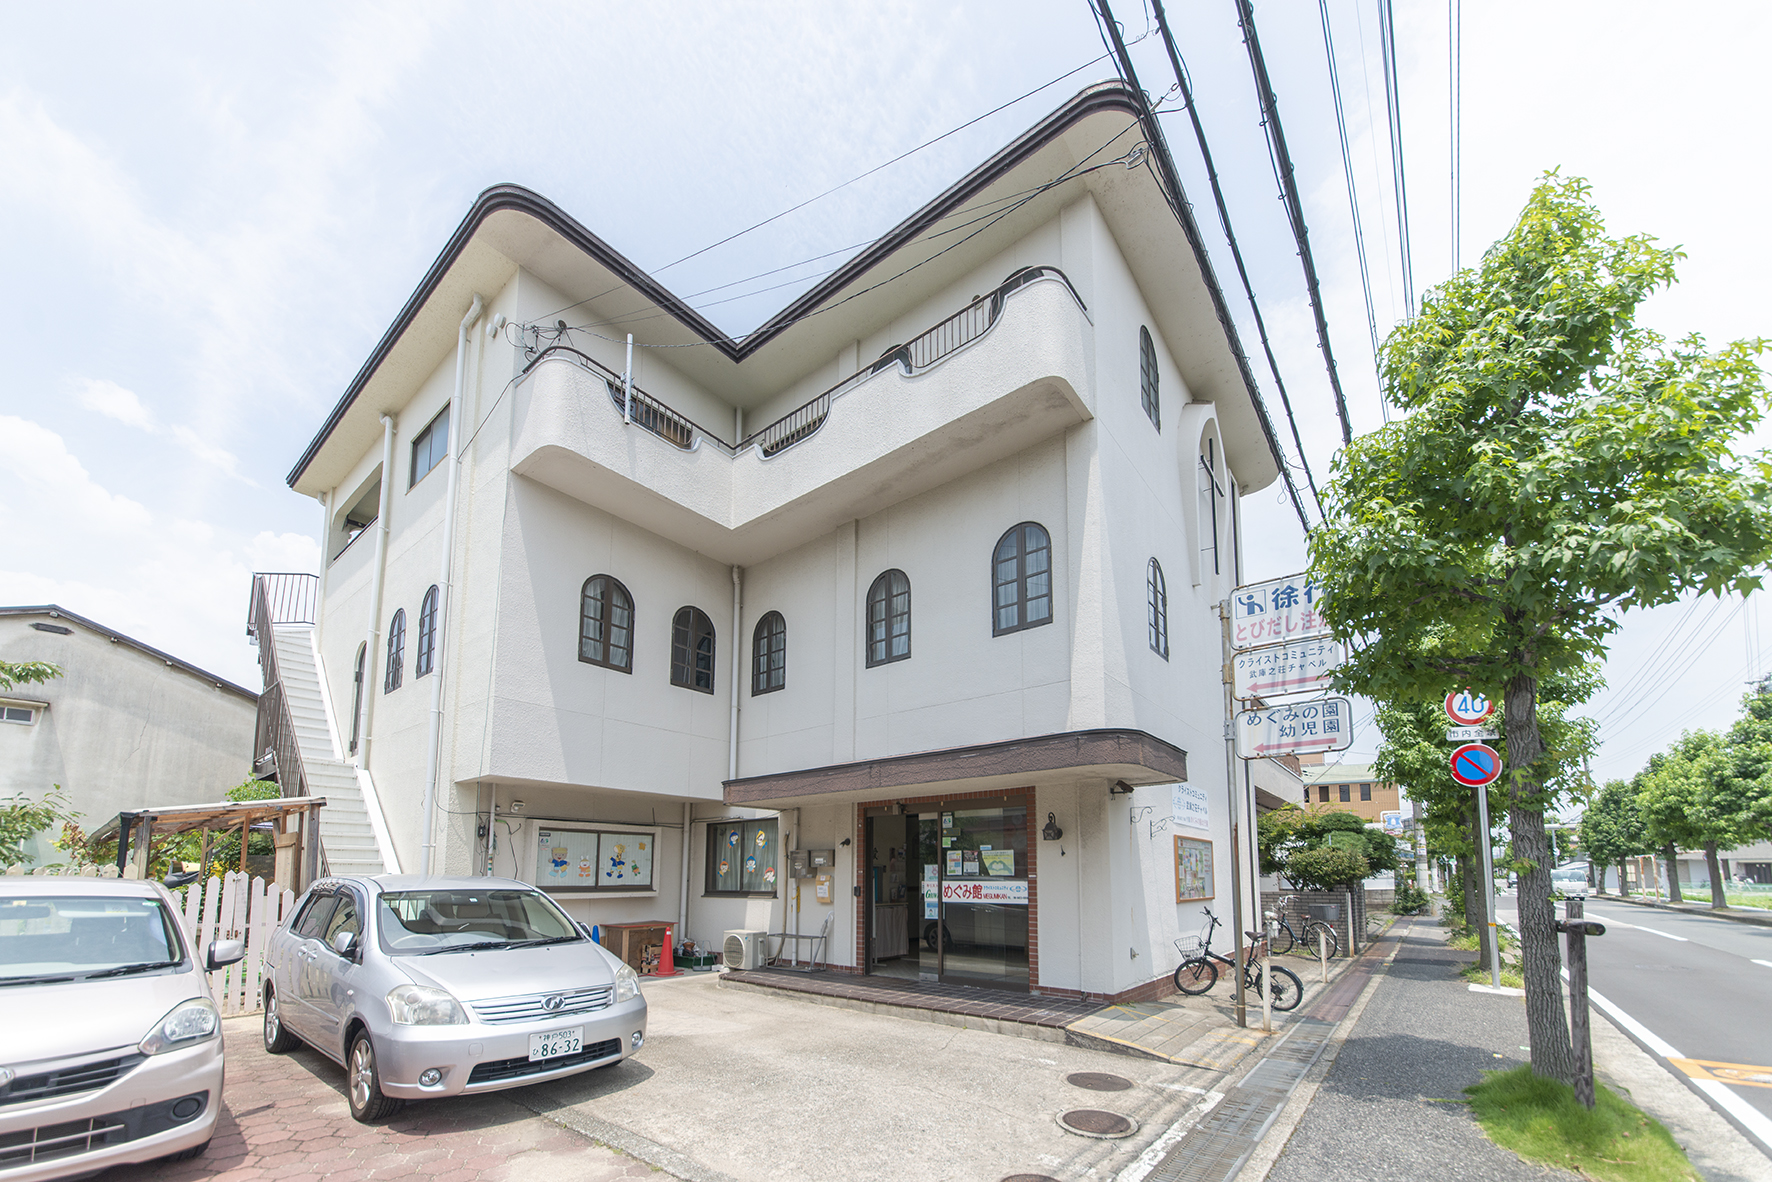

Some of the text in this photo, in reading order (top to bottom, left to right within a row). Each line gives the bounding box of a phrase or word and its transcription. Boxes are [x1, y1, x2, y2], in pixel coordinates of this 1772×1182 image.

[1239, 645, 1334, 669] クライストコミュニティ
[1249, 659, 1327, 679] 武庫之荘チャペル
[1246, 703, 1339, 727] めぐみの園
[1457, 696, 1485, 714] 40
[1279, 718, 1340, 738] 幼児園
[943, 884, 983, 900] めぐみ館
[541, 1038, 580, 1057] 86-32
